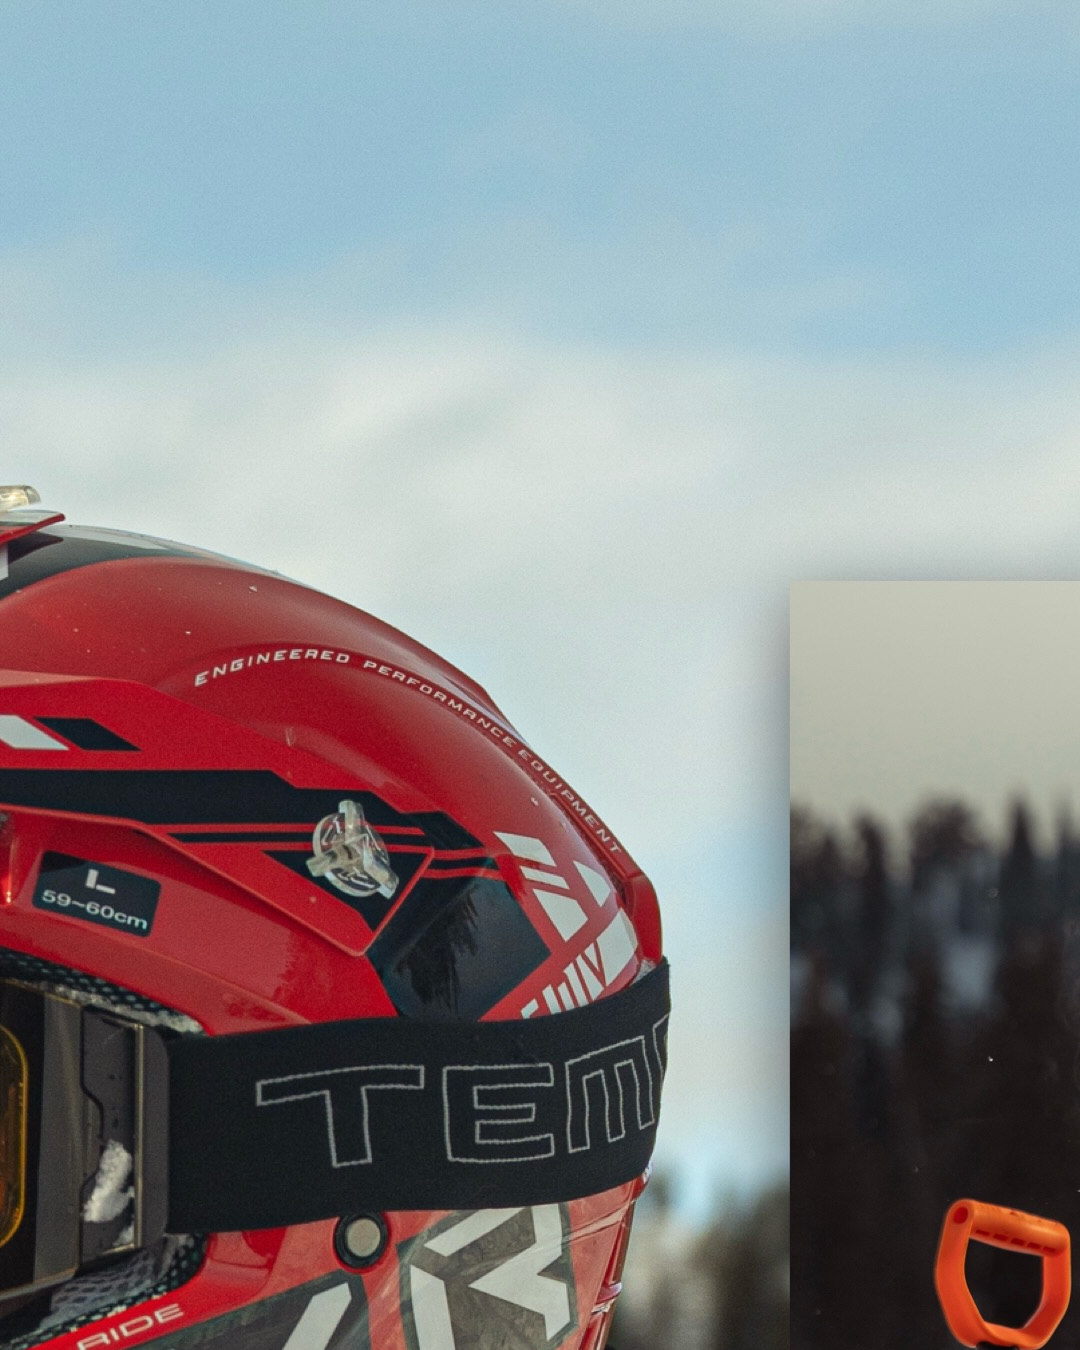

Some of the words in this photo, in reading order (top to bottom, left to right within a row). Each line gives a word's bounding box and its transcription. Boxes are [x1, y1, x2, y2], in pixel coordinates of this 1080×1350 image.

[194, 648, 350, 687] ENGINEERED
[363, 660, 517, 748] PERFORMANCE
[518, 749, 622, 854] EQUIPMENT
[85, 868, 116, 894] L
